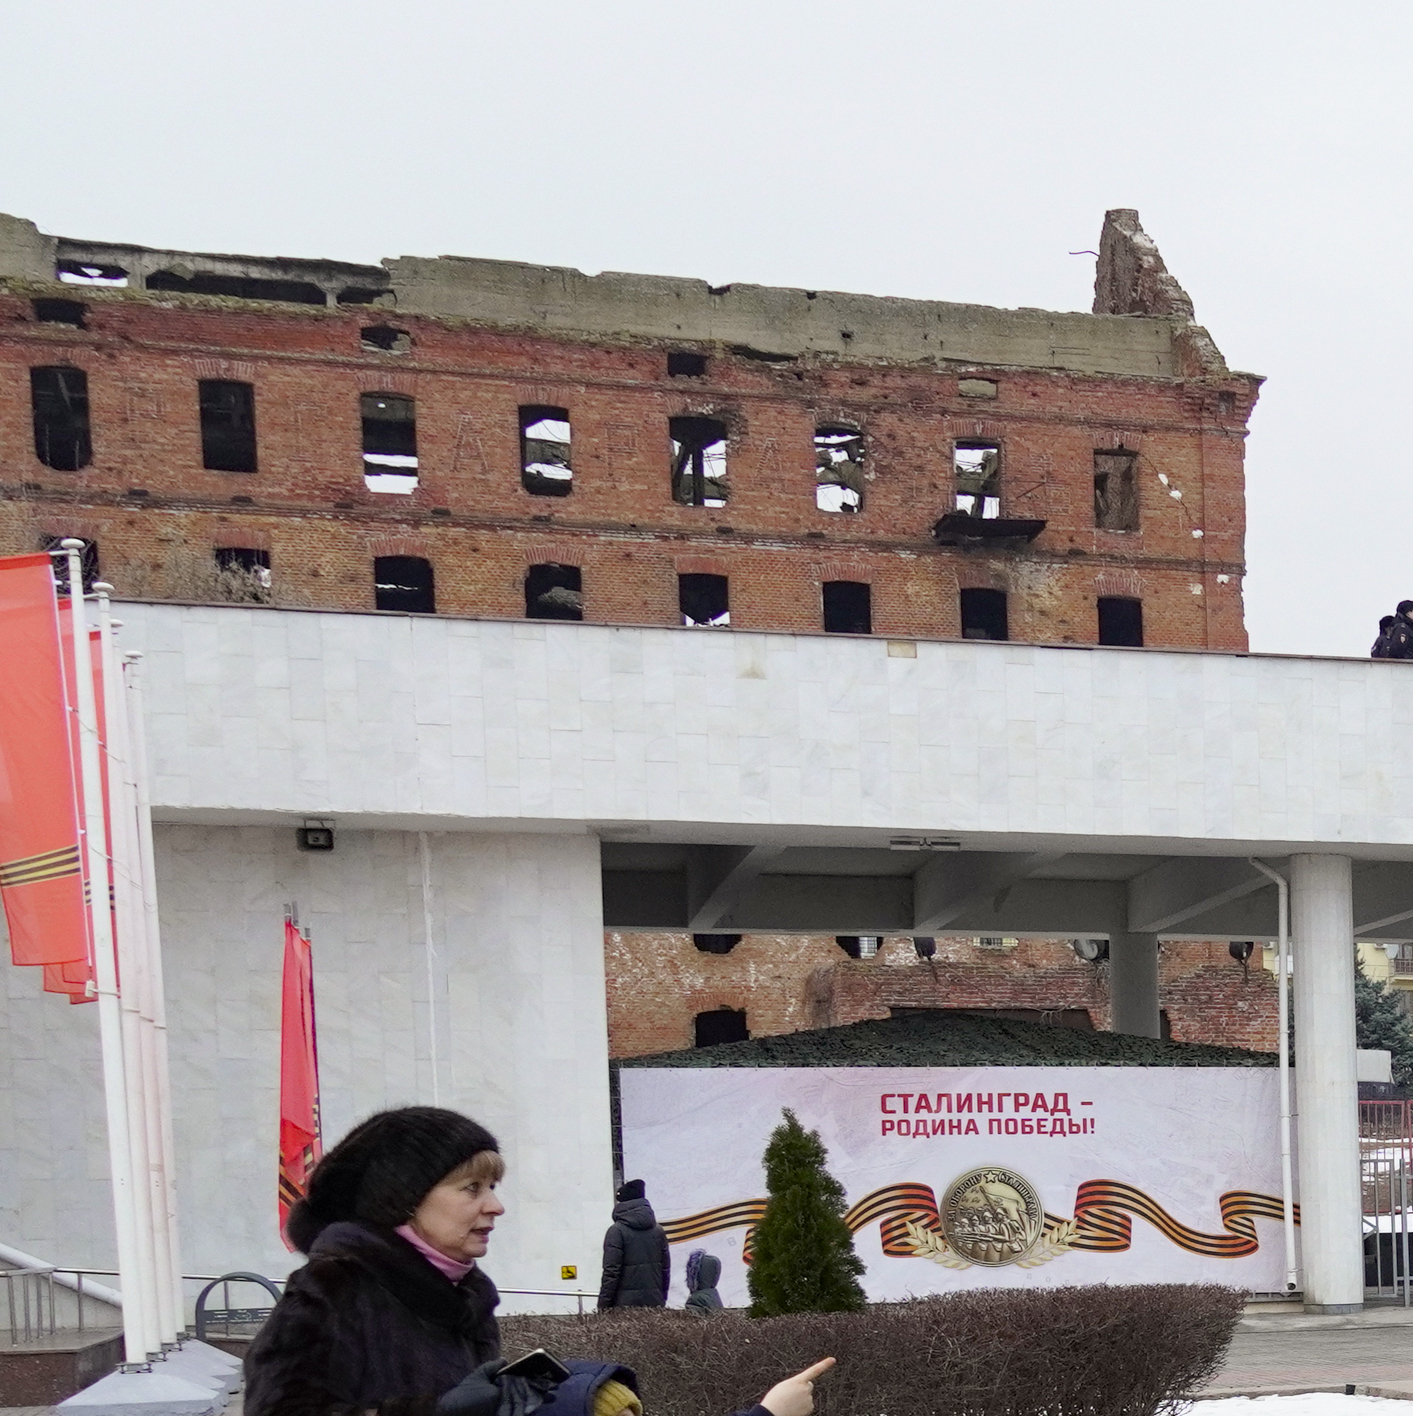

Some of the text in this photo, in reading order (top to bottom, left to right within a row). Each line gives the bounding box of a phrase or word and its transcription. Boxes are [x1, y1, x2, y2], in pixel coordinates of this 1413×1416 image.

[881, 1092, 1071, 1116] СТАЛИНГРАД
[881, 1117, 1095, 1139] РОДИНА ПОБЕДЫ!
